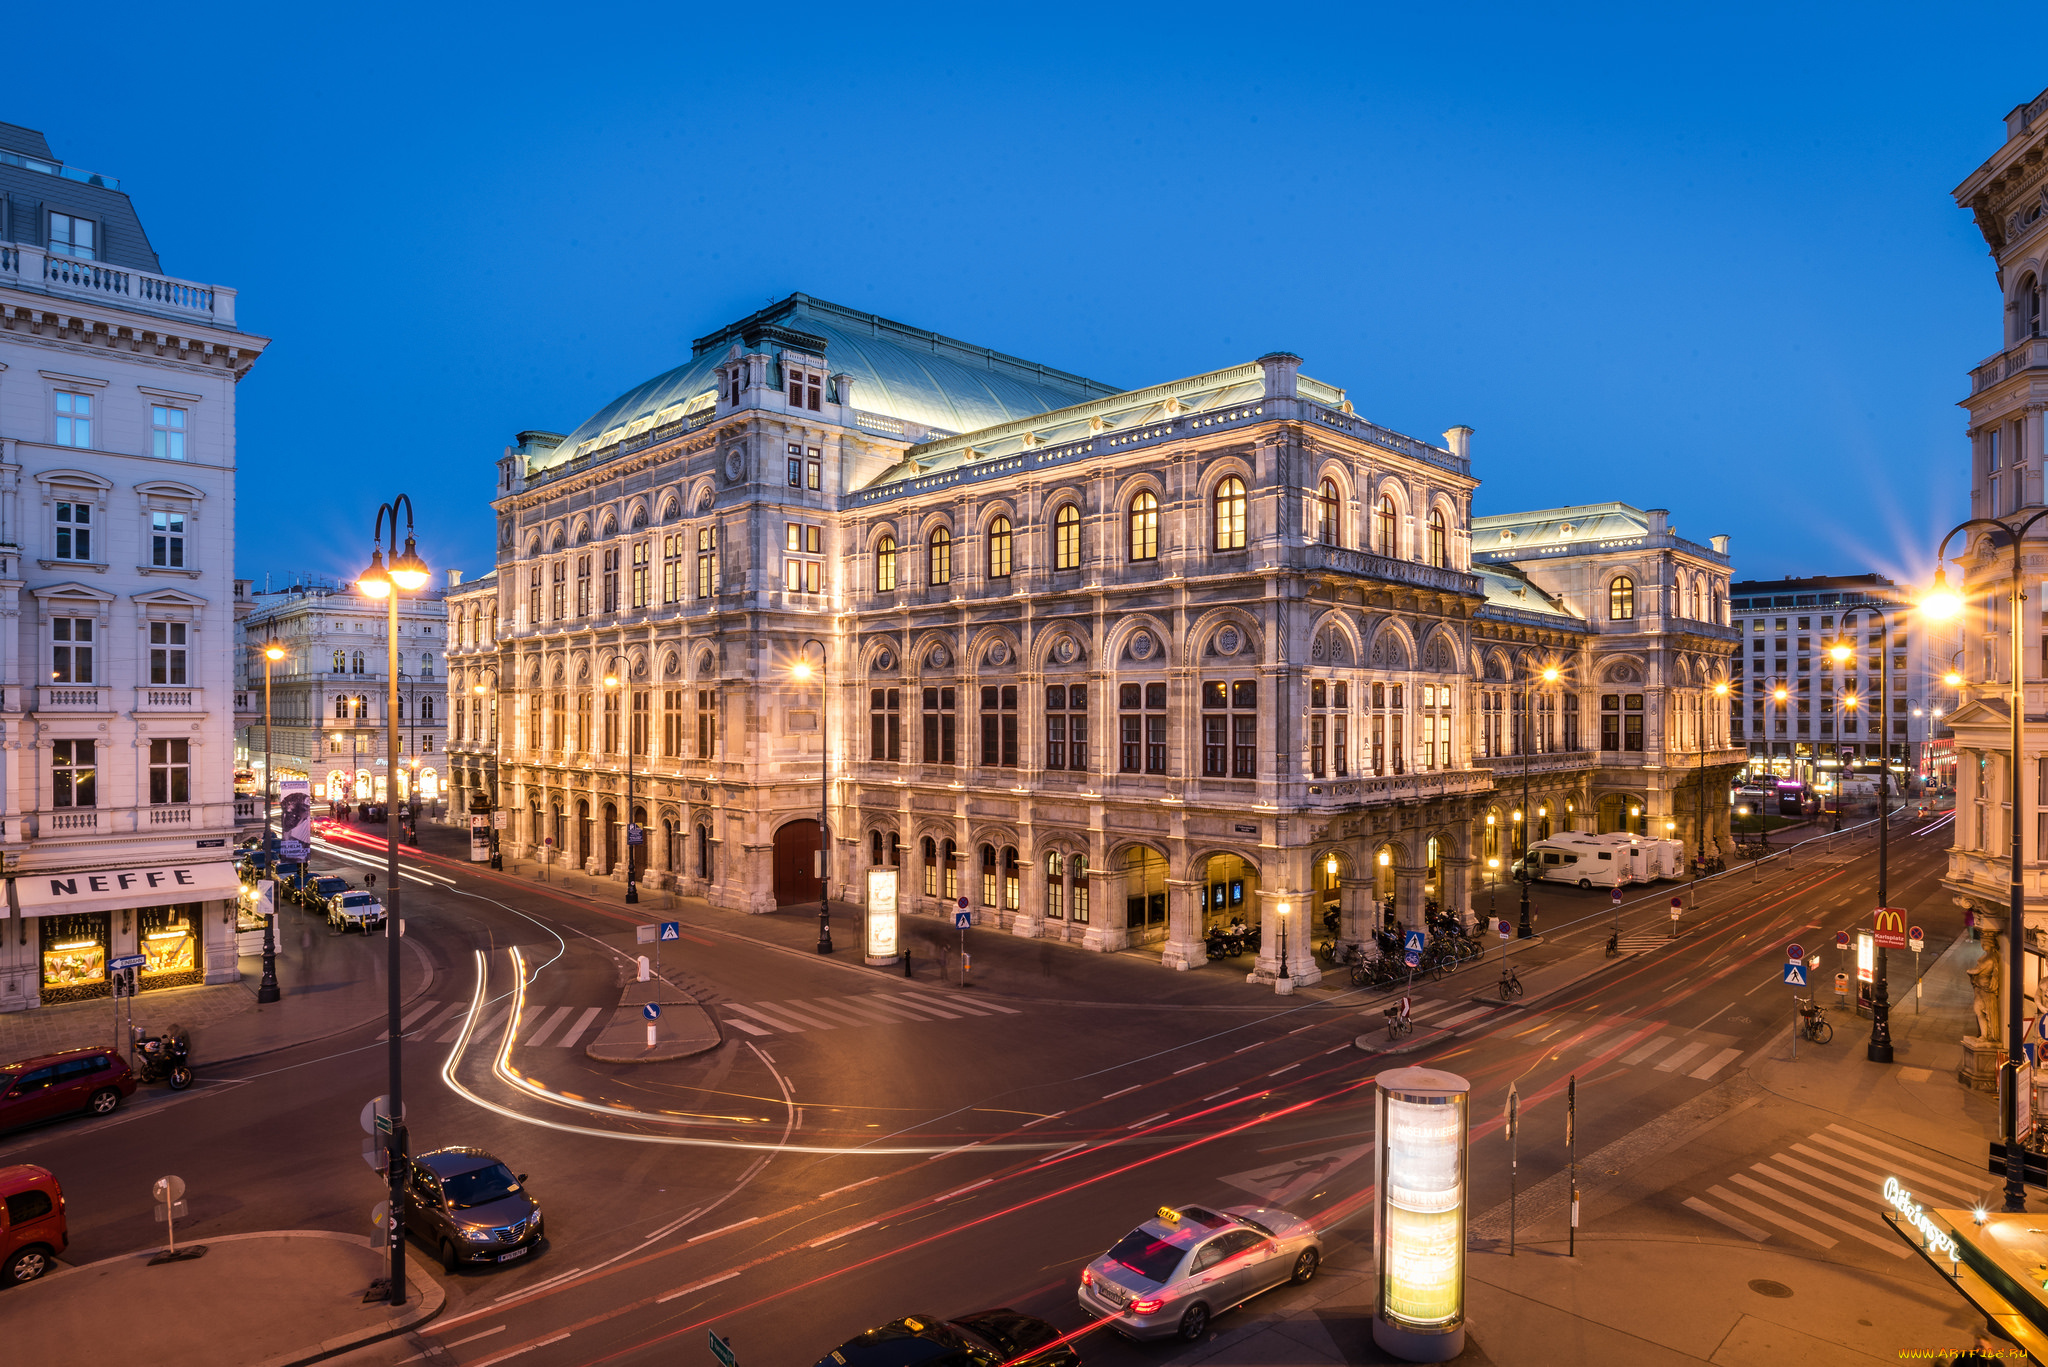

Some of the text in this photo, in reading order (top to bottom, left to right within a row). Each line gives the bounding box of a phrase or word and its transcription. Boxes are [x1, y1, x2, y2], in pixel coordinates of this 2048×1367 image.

[50, 869, 195, 896] NEFFE
[1875, 933, 1905, 942] Karlsplatz
[121, 958, 143, 966] EINBAHN
[1397, 1124, 1458, 1138] ANSELM KIEFER
[1884, 1177, 1961, 1262] Bitzinger
